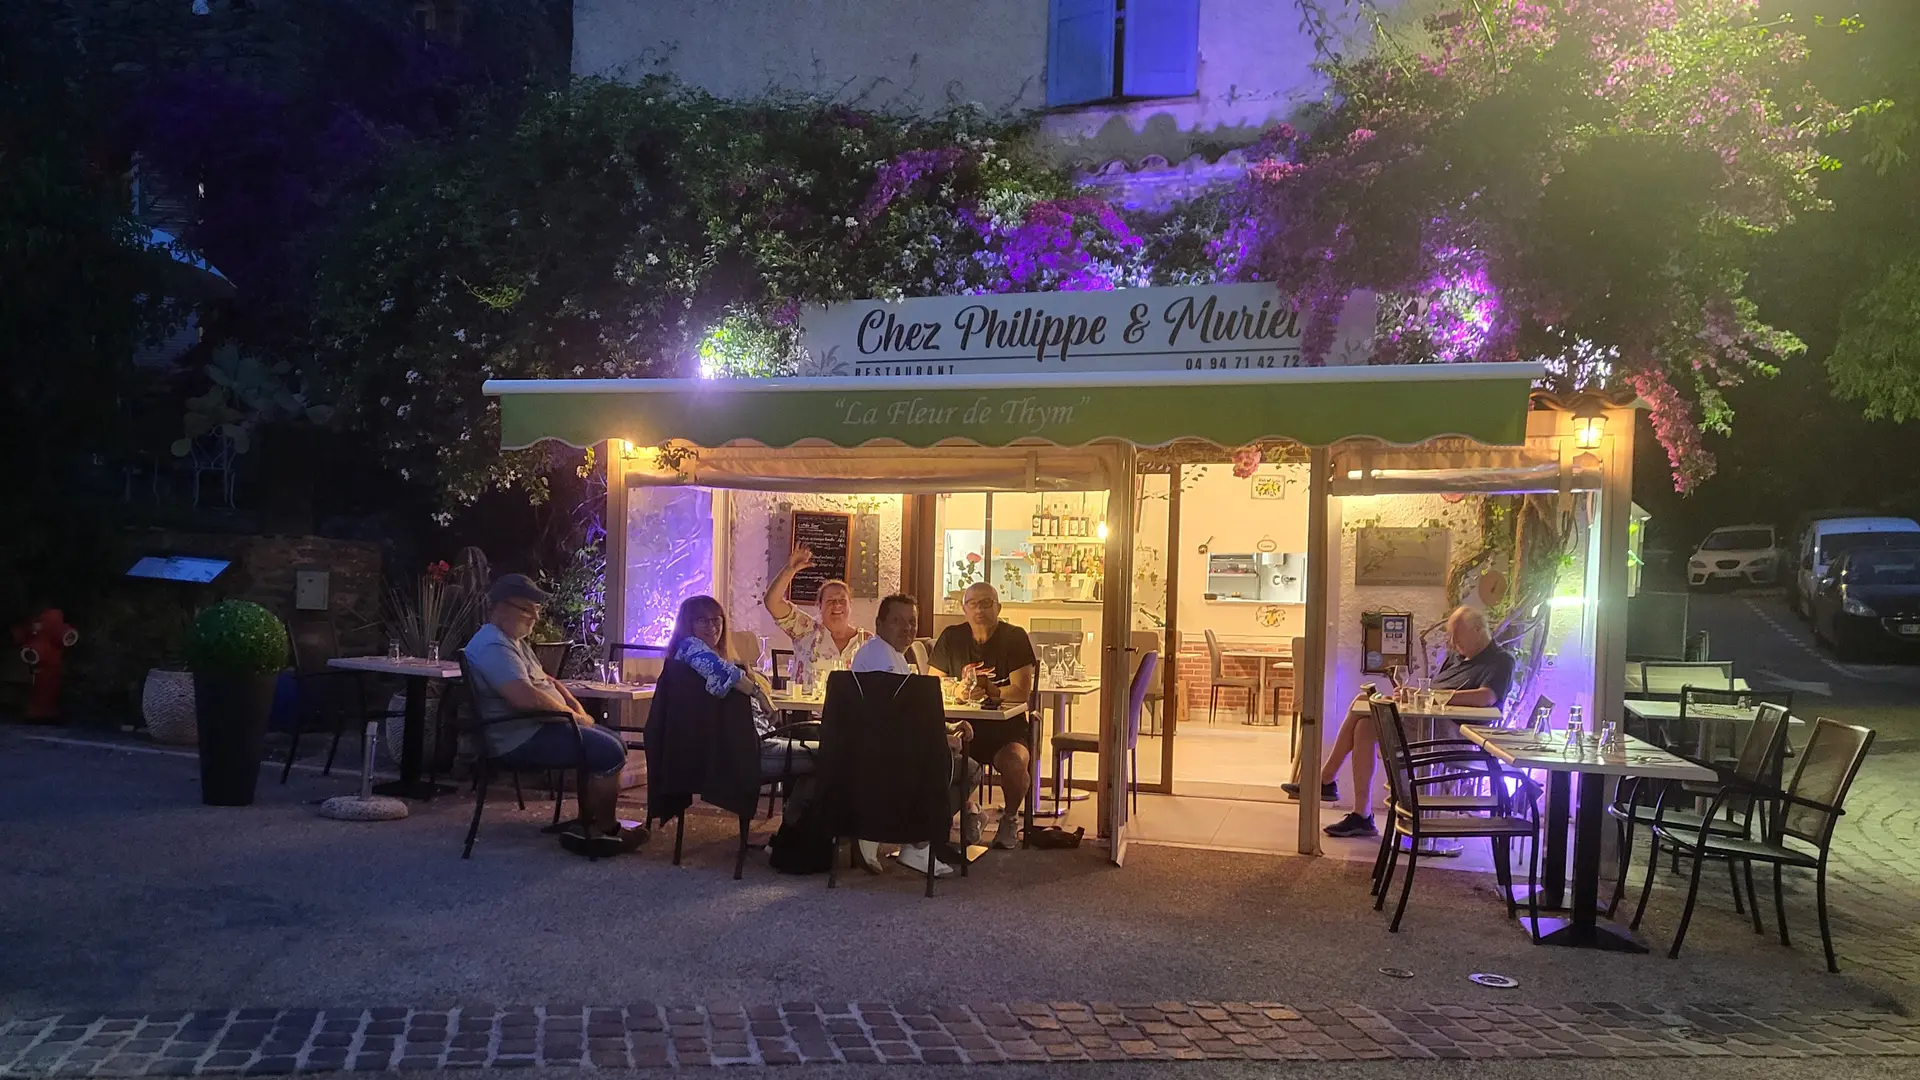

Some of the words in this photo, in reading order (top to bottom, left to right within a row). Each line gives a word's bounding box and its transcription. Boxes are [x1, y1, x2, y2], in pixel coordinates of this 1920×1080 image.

[857, 309, 942, 354] Chez
[954, 305, 1107, 363] Philippe
[1122, 303, 1151, 344] &
[1185, 357, 1202, 370] 04
[1210, 356, 1227, 369] 94
[1235, 355, 1250, 369] 71
[1257, 355, 1275, 368] 42
[1283, 354, 1300, 367] 72
[887, 396, 960, 425] Fleur
[962, 396, 992, 425] de
